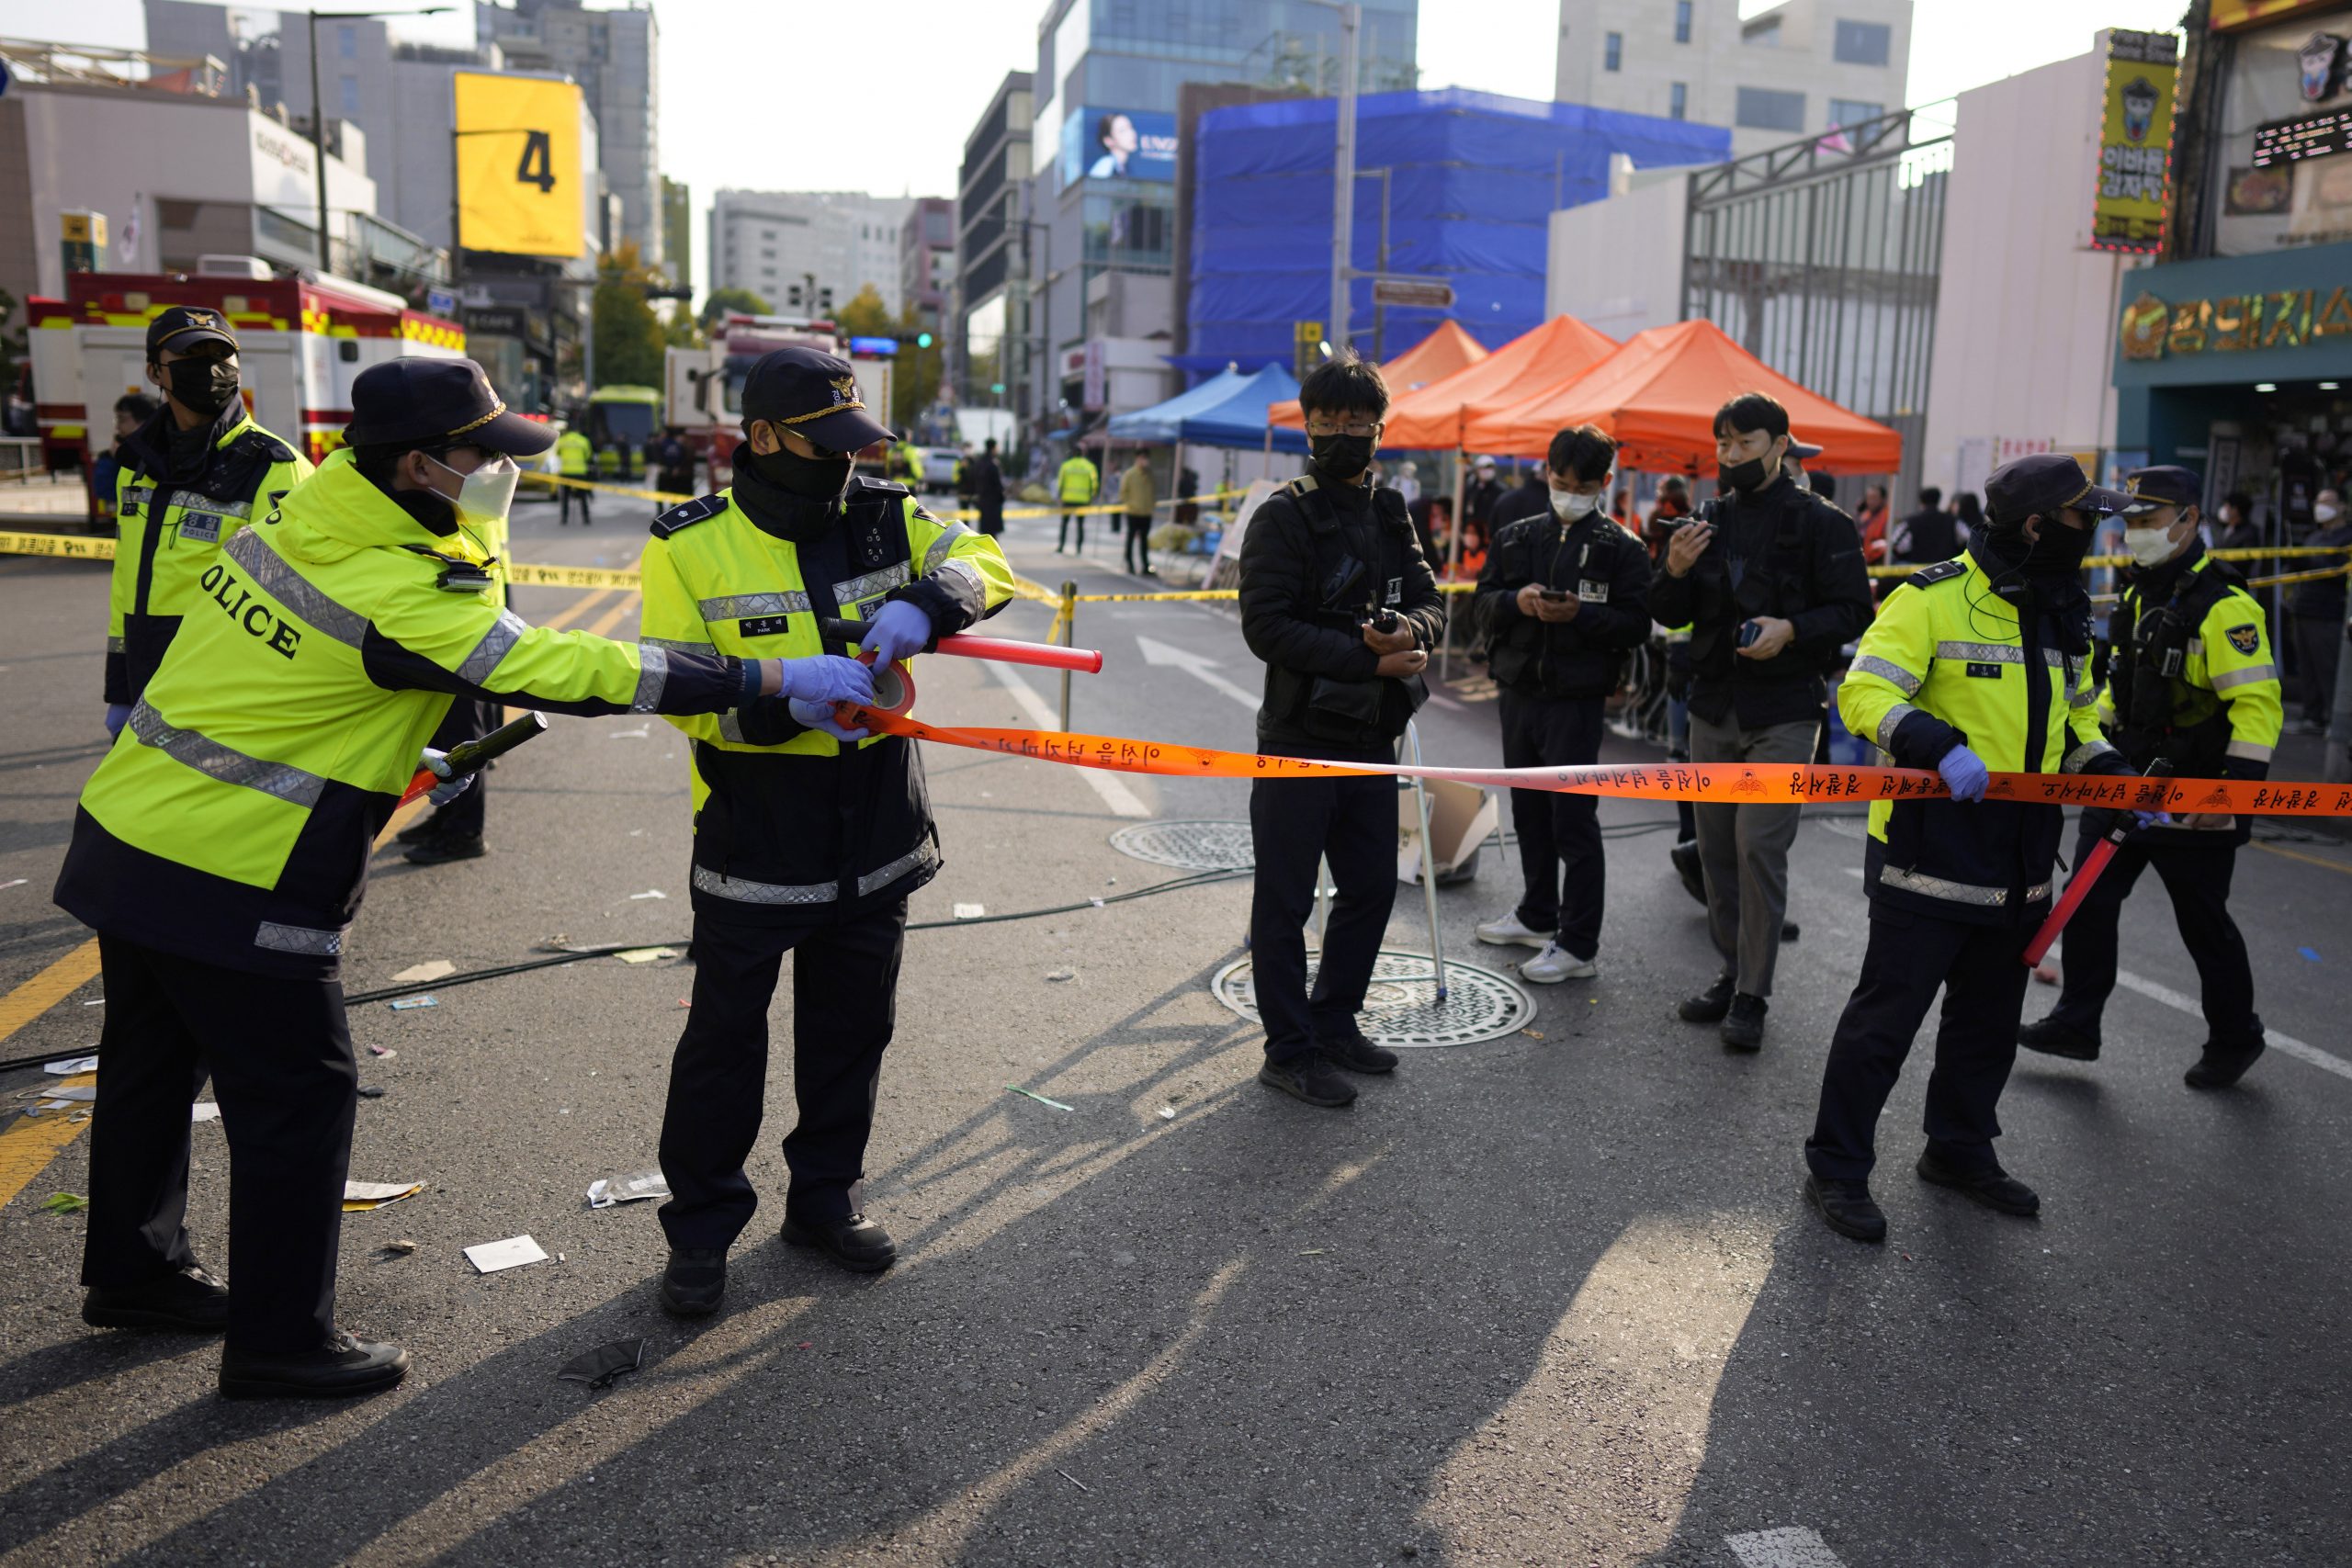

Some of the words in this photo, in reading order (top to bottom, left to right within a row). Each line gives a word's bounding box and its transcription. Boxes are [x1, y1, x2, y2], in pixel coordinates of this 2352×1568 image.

[517, 130, 556, 194] 4
[188, 513, 217, 530] 경찰
[184, 527, 215, 540] POLICE
[201, 565, 301, 660] OLICE
[1657, 769, 1711, 792] 이선을
[1790, 773, 1861, 796] 경찰서장
[2135, 784, 2184, 805] 이선을
[2253, 788, 2321, 809] 경찰서장
